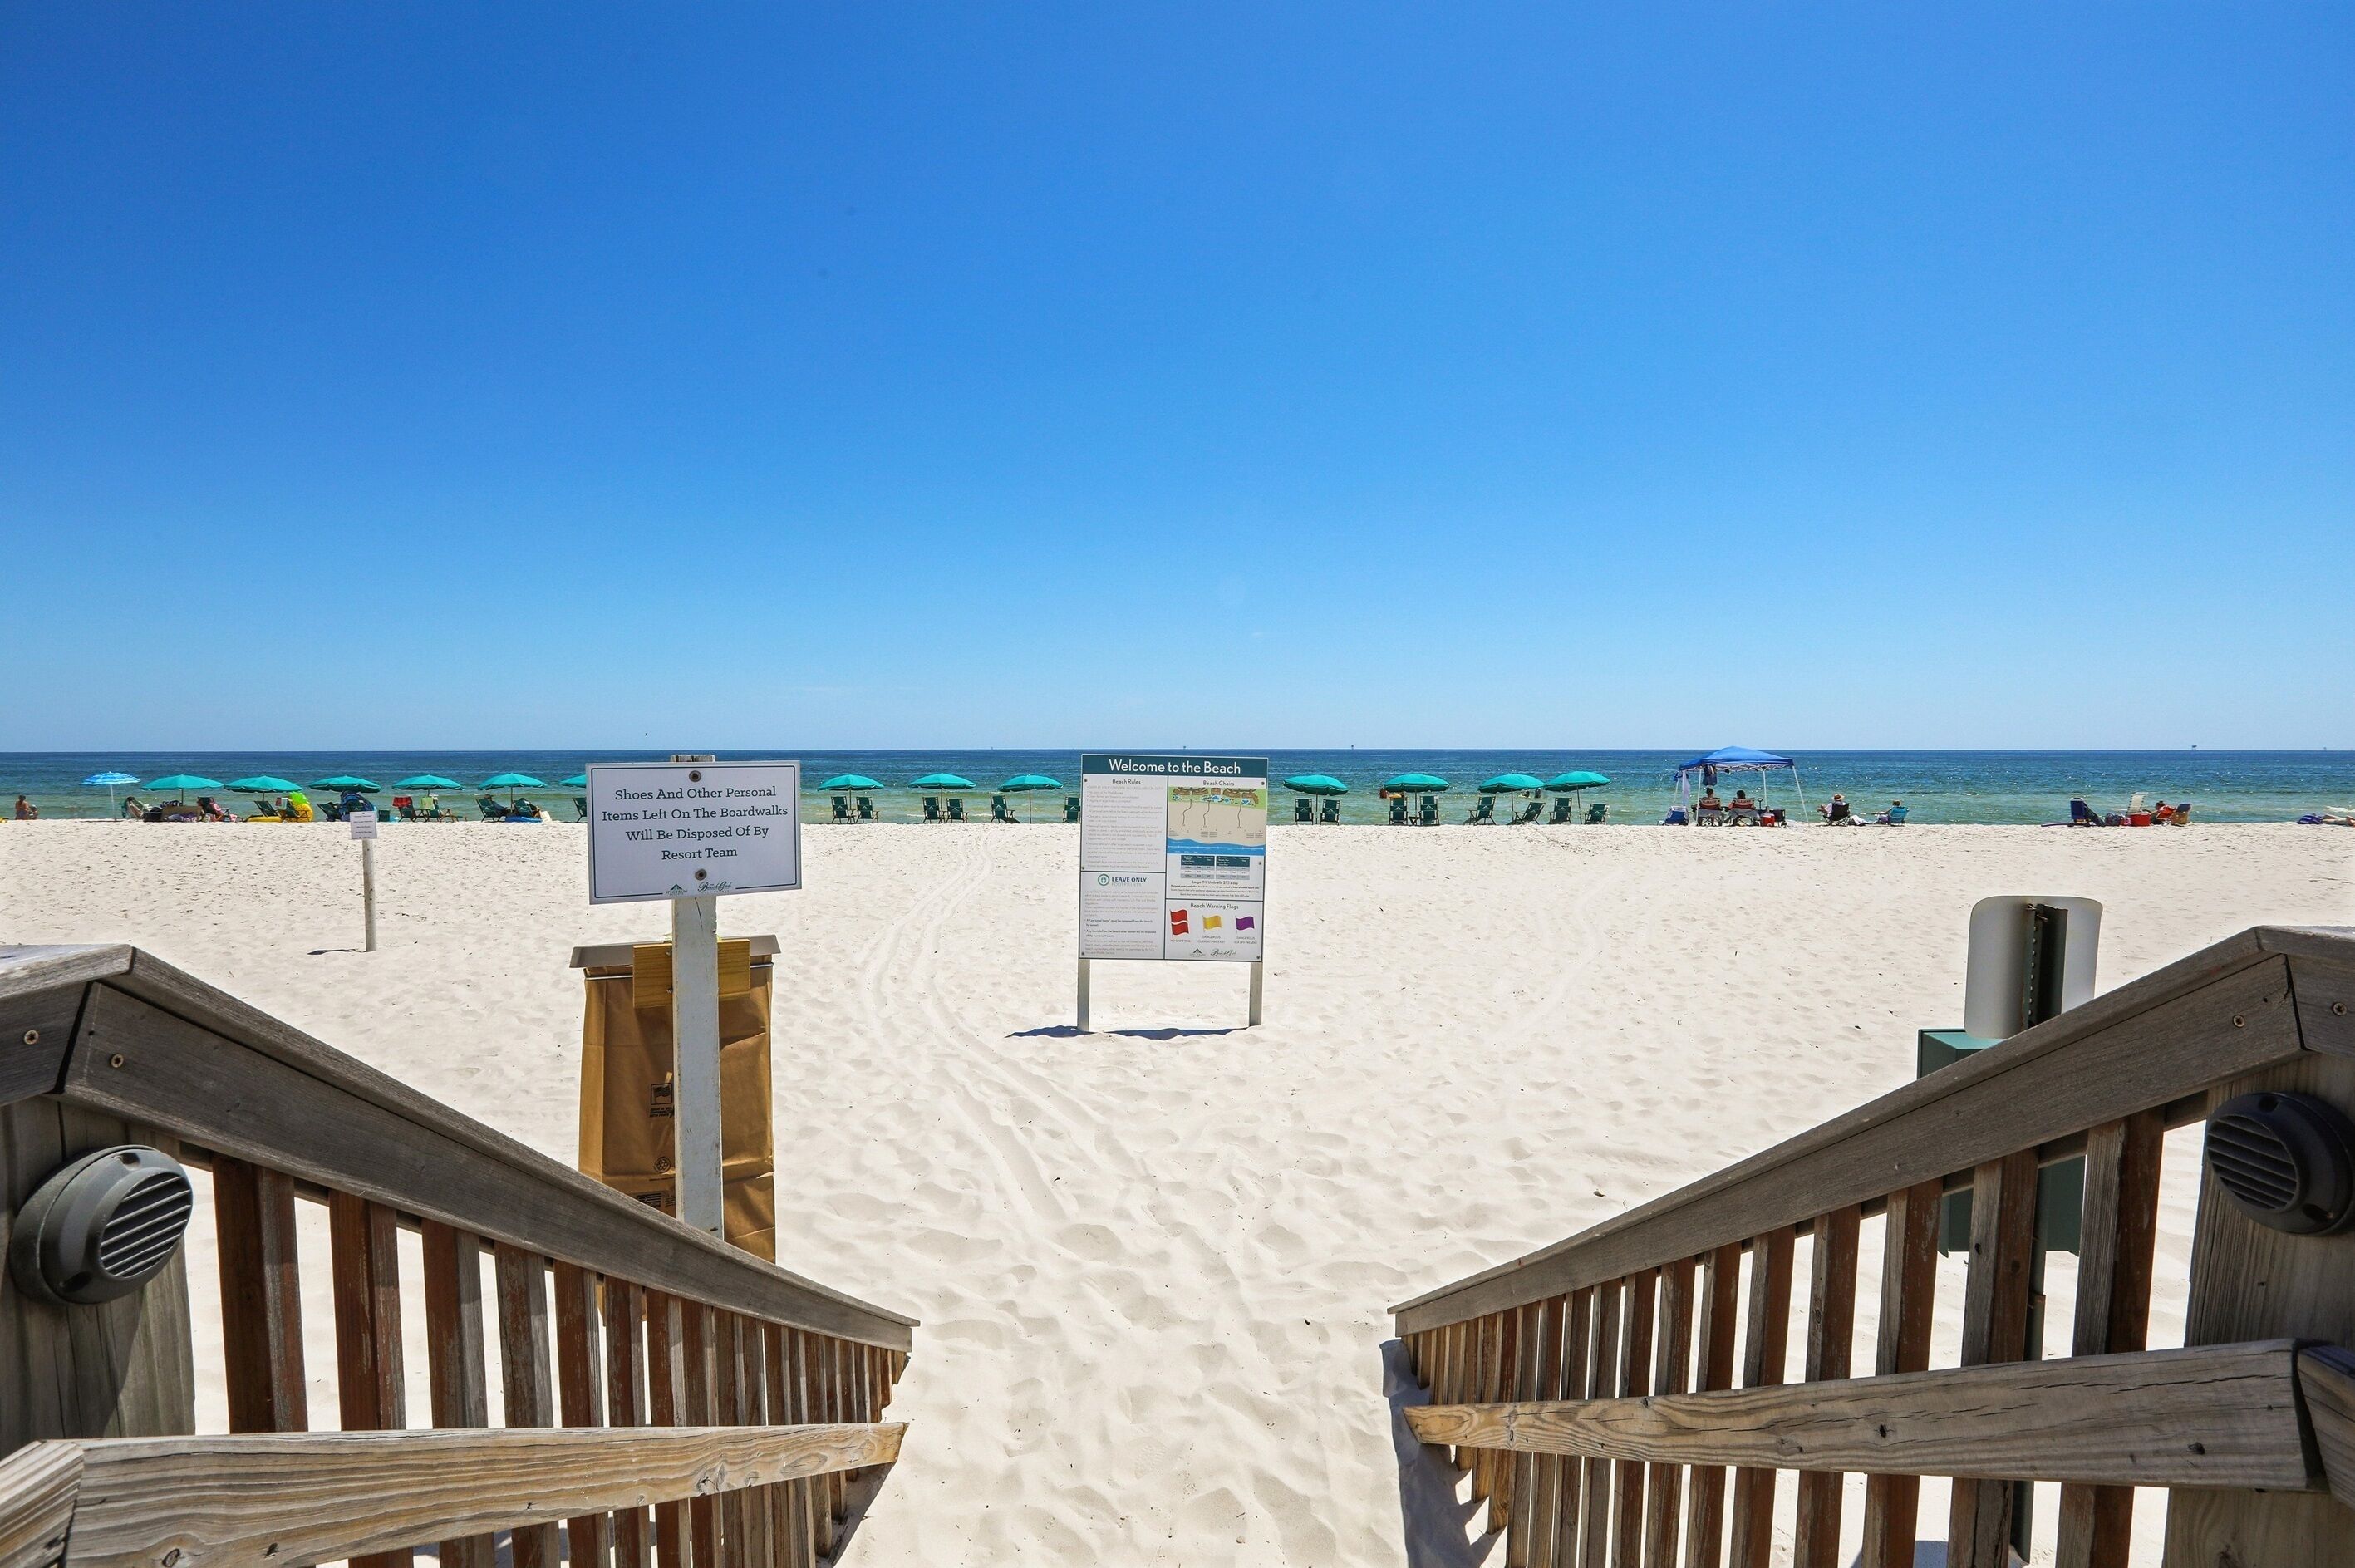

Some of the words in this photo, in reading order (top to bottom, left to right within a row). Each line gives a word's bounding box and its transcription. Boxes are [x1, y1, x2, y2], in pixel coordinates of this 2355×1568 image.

[1109, 759, 1166, 773] Welcome
[1168, 761, 1180, 773] to
[1182, 761, 1202, 774] the
[1203, 761, 1241, 774] Beach
[615, 789, 653, 800] Shoes
[656, 788, 684, 799] And
[686, 787, 723, 799] Other
[725, 786, 777, 798] Personal
[602, 810, 639, 822] Items
[642, 809, 668, 820] Left
[671, 809, 691, 819] On
[693, 808, 717, 818] The
[720, 805, 789, 818] Boardwalks
[626, 829, 653, 841] Will
[656, 830, 673, 840] Be
[676, 827, 733, 841] Disposed
[735, 826, 751, 837] Of
[753, 826, 769, 838] By
[661, 849, 702, 860] Resort
[704, 848, 738, 858] Team
